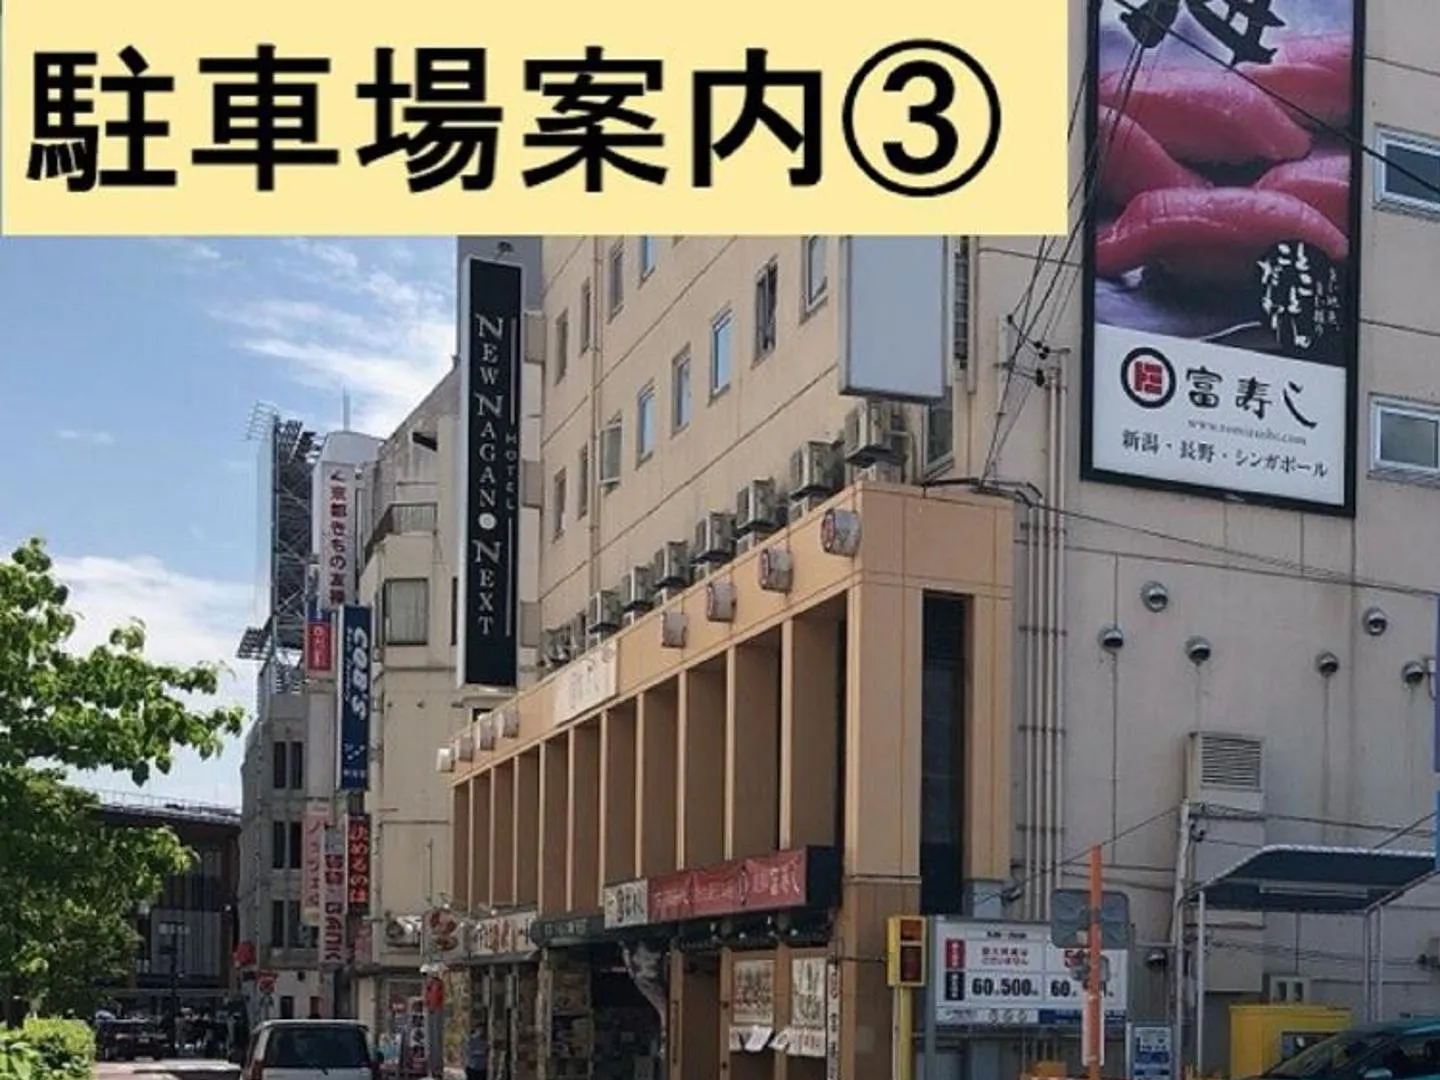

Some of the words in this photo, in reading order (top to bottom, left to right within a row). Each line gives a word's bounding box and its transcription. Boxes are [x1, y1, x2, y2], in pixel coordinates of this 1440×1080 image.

[475, 314, 504, 386] NEW
[505, 432, 518, 510] HOTEL
[473, 540, 502, 636] NEXT
